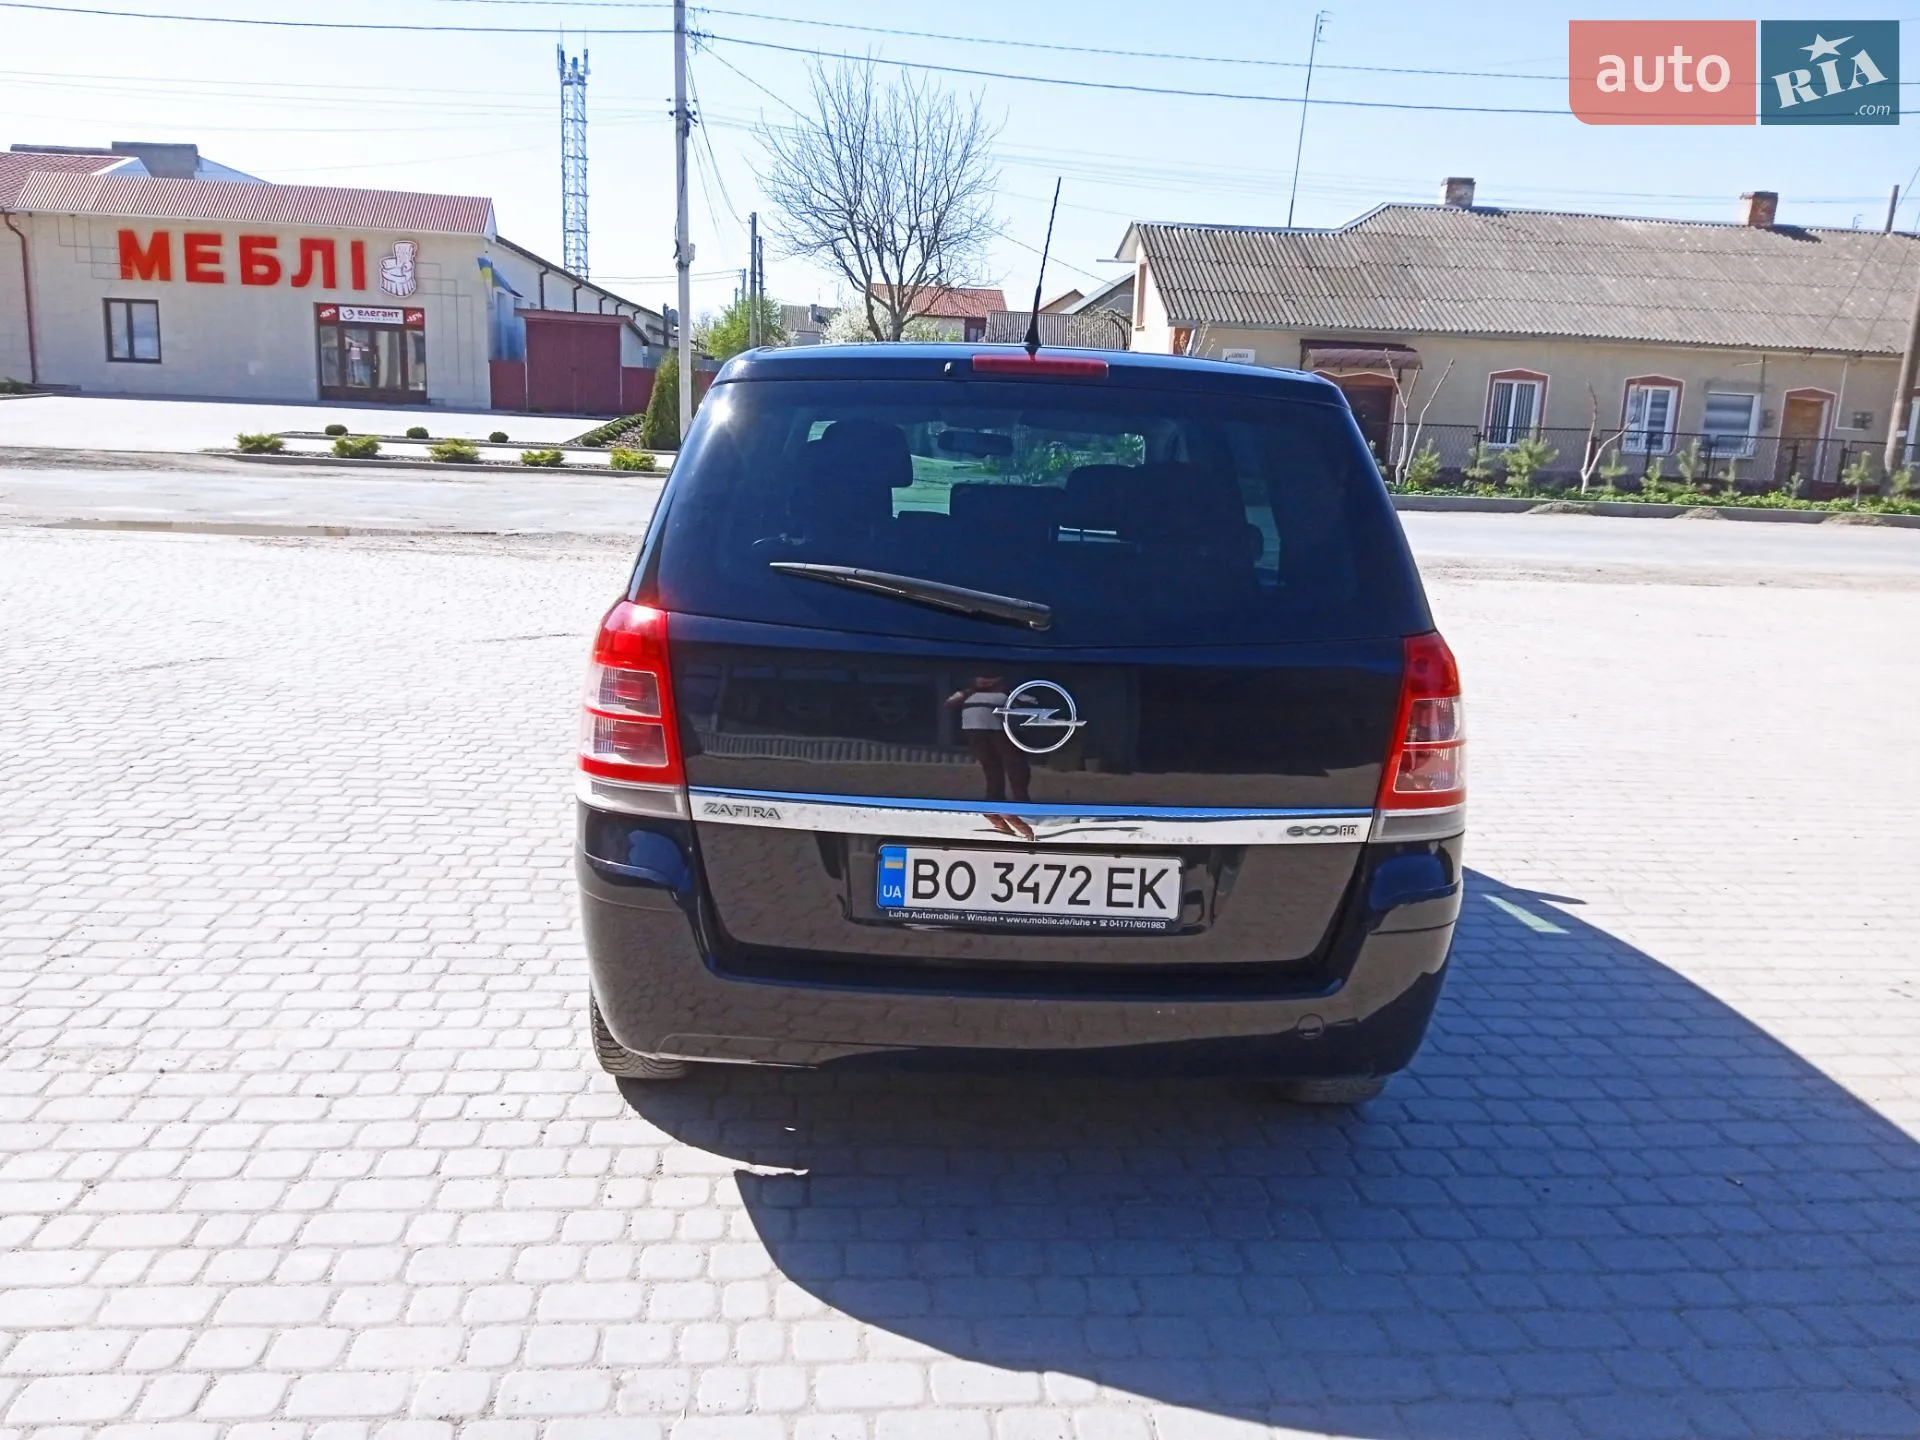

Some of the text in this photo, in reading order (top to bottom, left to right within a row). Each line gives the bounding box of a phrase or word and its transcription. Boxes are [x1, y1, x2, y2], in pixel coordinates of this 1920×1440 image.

[118, 229, 366, 291] МЕБЛІ
[704, 802, 781, 820] ZAFIRA
[883, 884, 902, 898] UA
[912, 858, 1169, 910] BO 3472 EK
[888, 910, 909, 918] Luhe
[911, 911, 959, 921] Automobile
